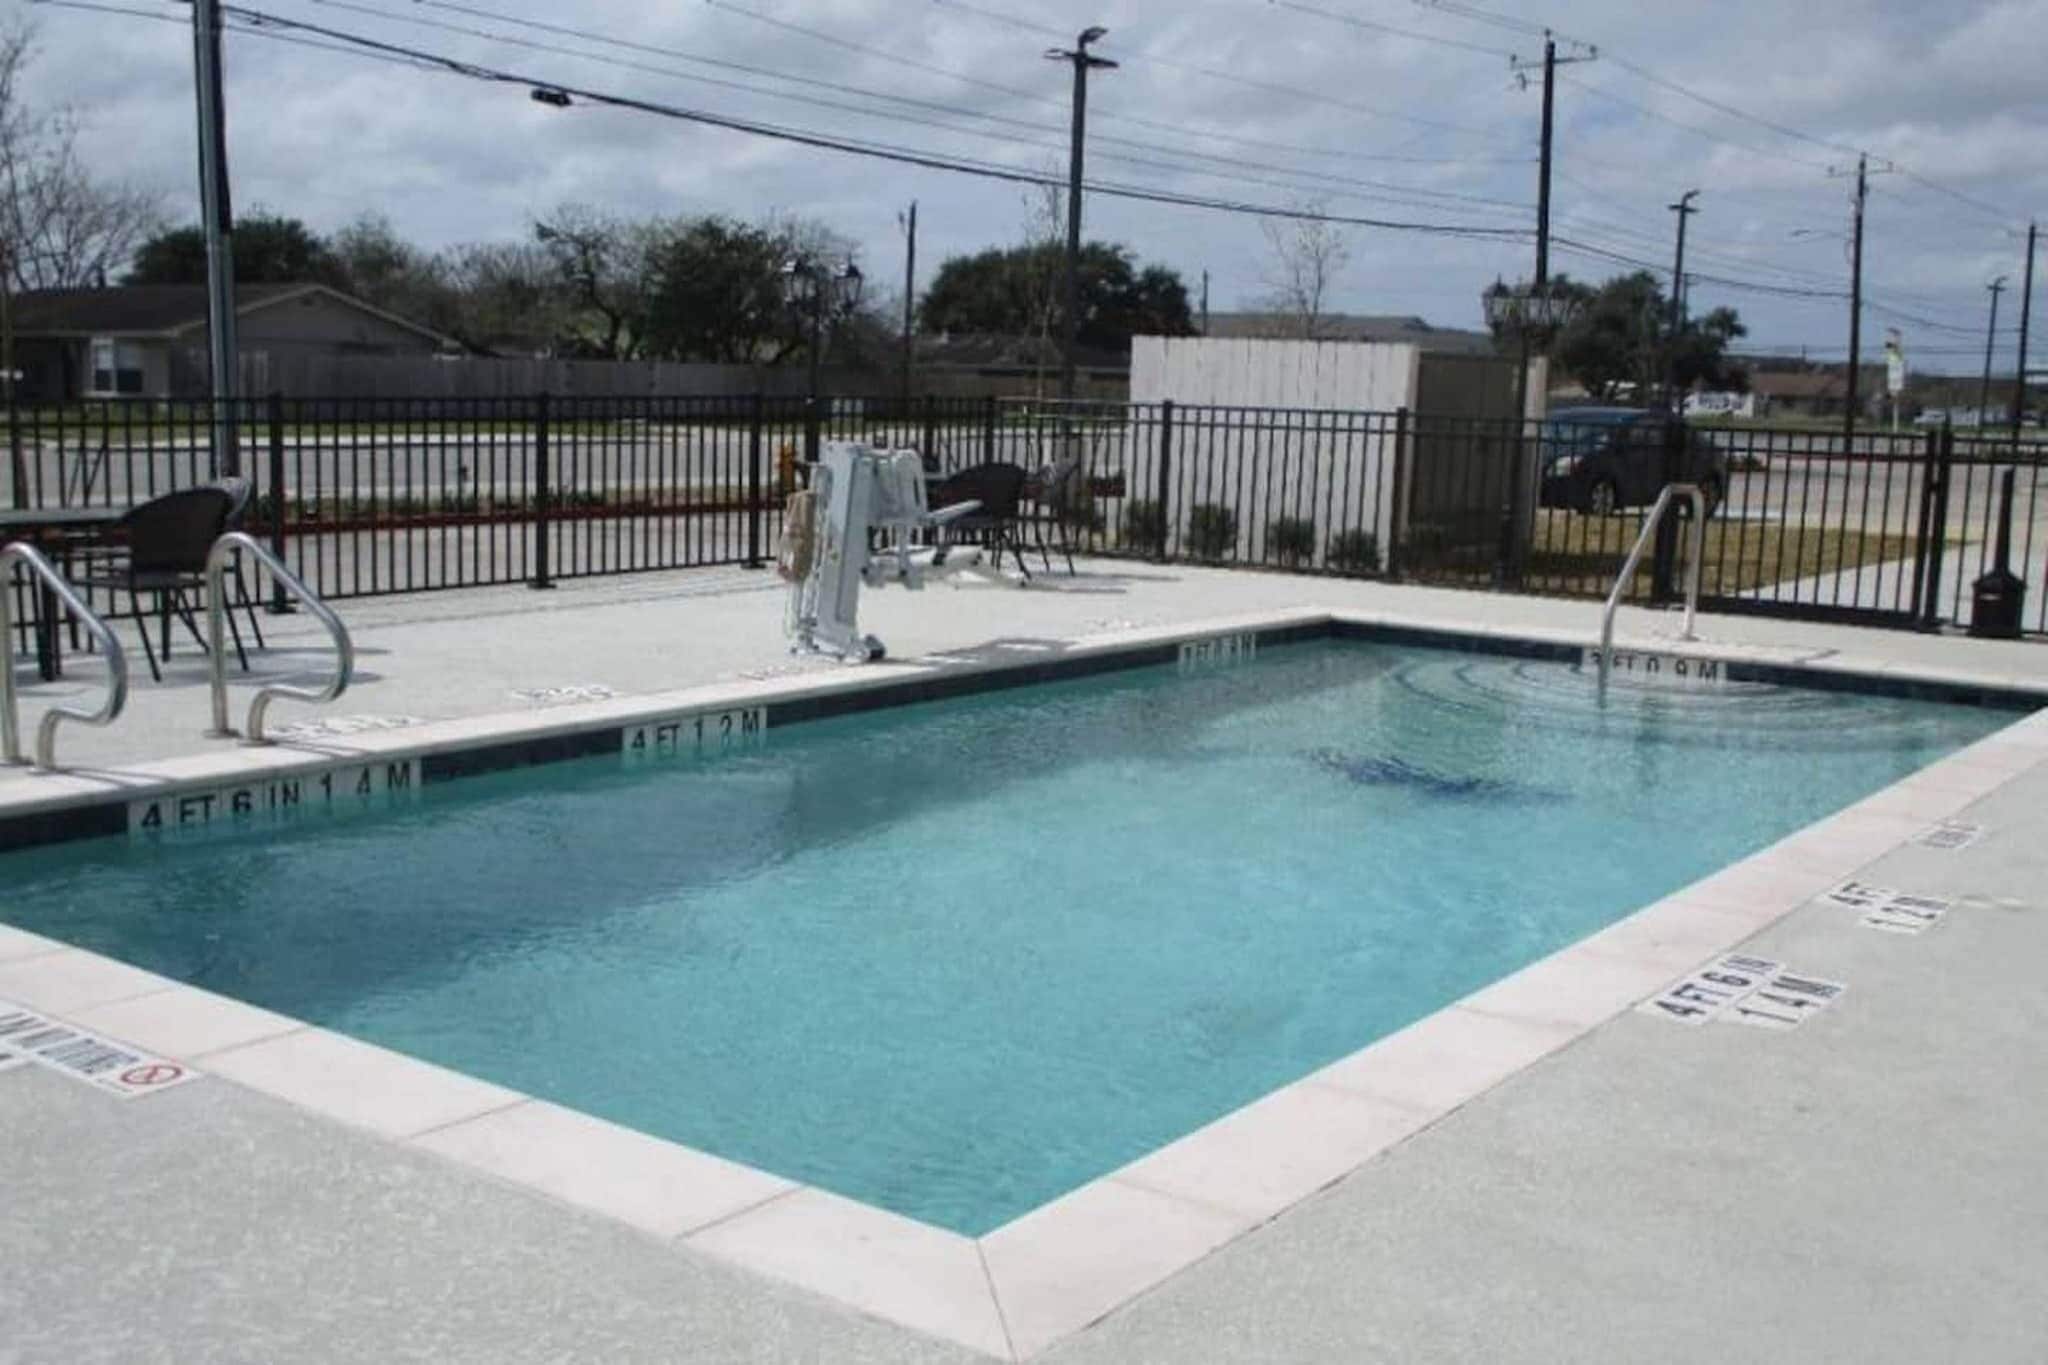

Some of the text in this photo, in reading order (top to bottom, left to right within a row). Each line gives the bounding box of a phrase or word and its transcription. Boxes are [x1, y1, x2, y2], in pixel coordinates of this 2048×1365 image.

[1699, 661, 1717, 680] M
[632, 728, 645, 749] 4
[657, 724, 680, 746] FT
[742, 710, 759, 735] M
[142, 803, 161, 828] 4
[180, 795, 215, 823] FT
[269, 782, 299, 808] IN
[387, 762, 410, 791] M
